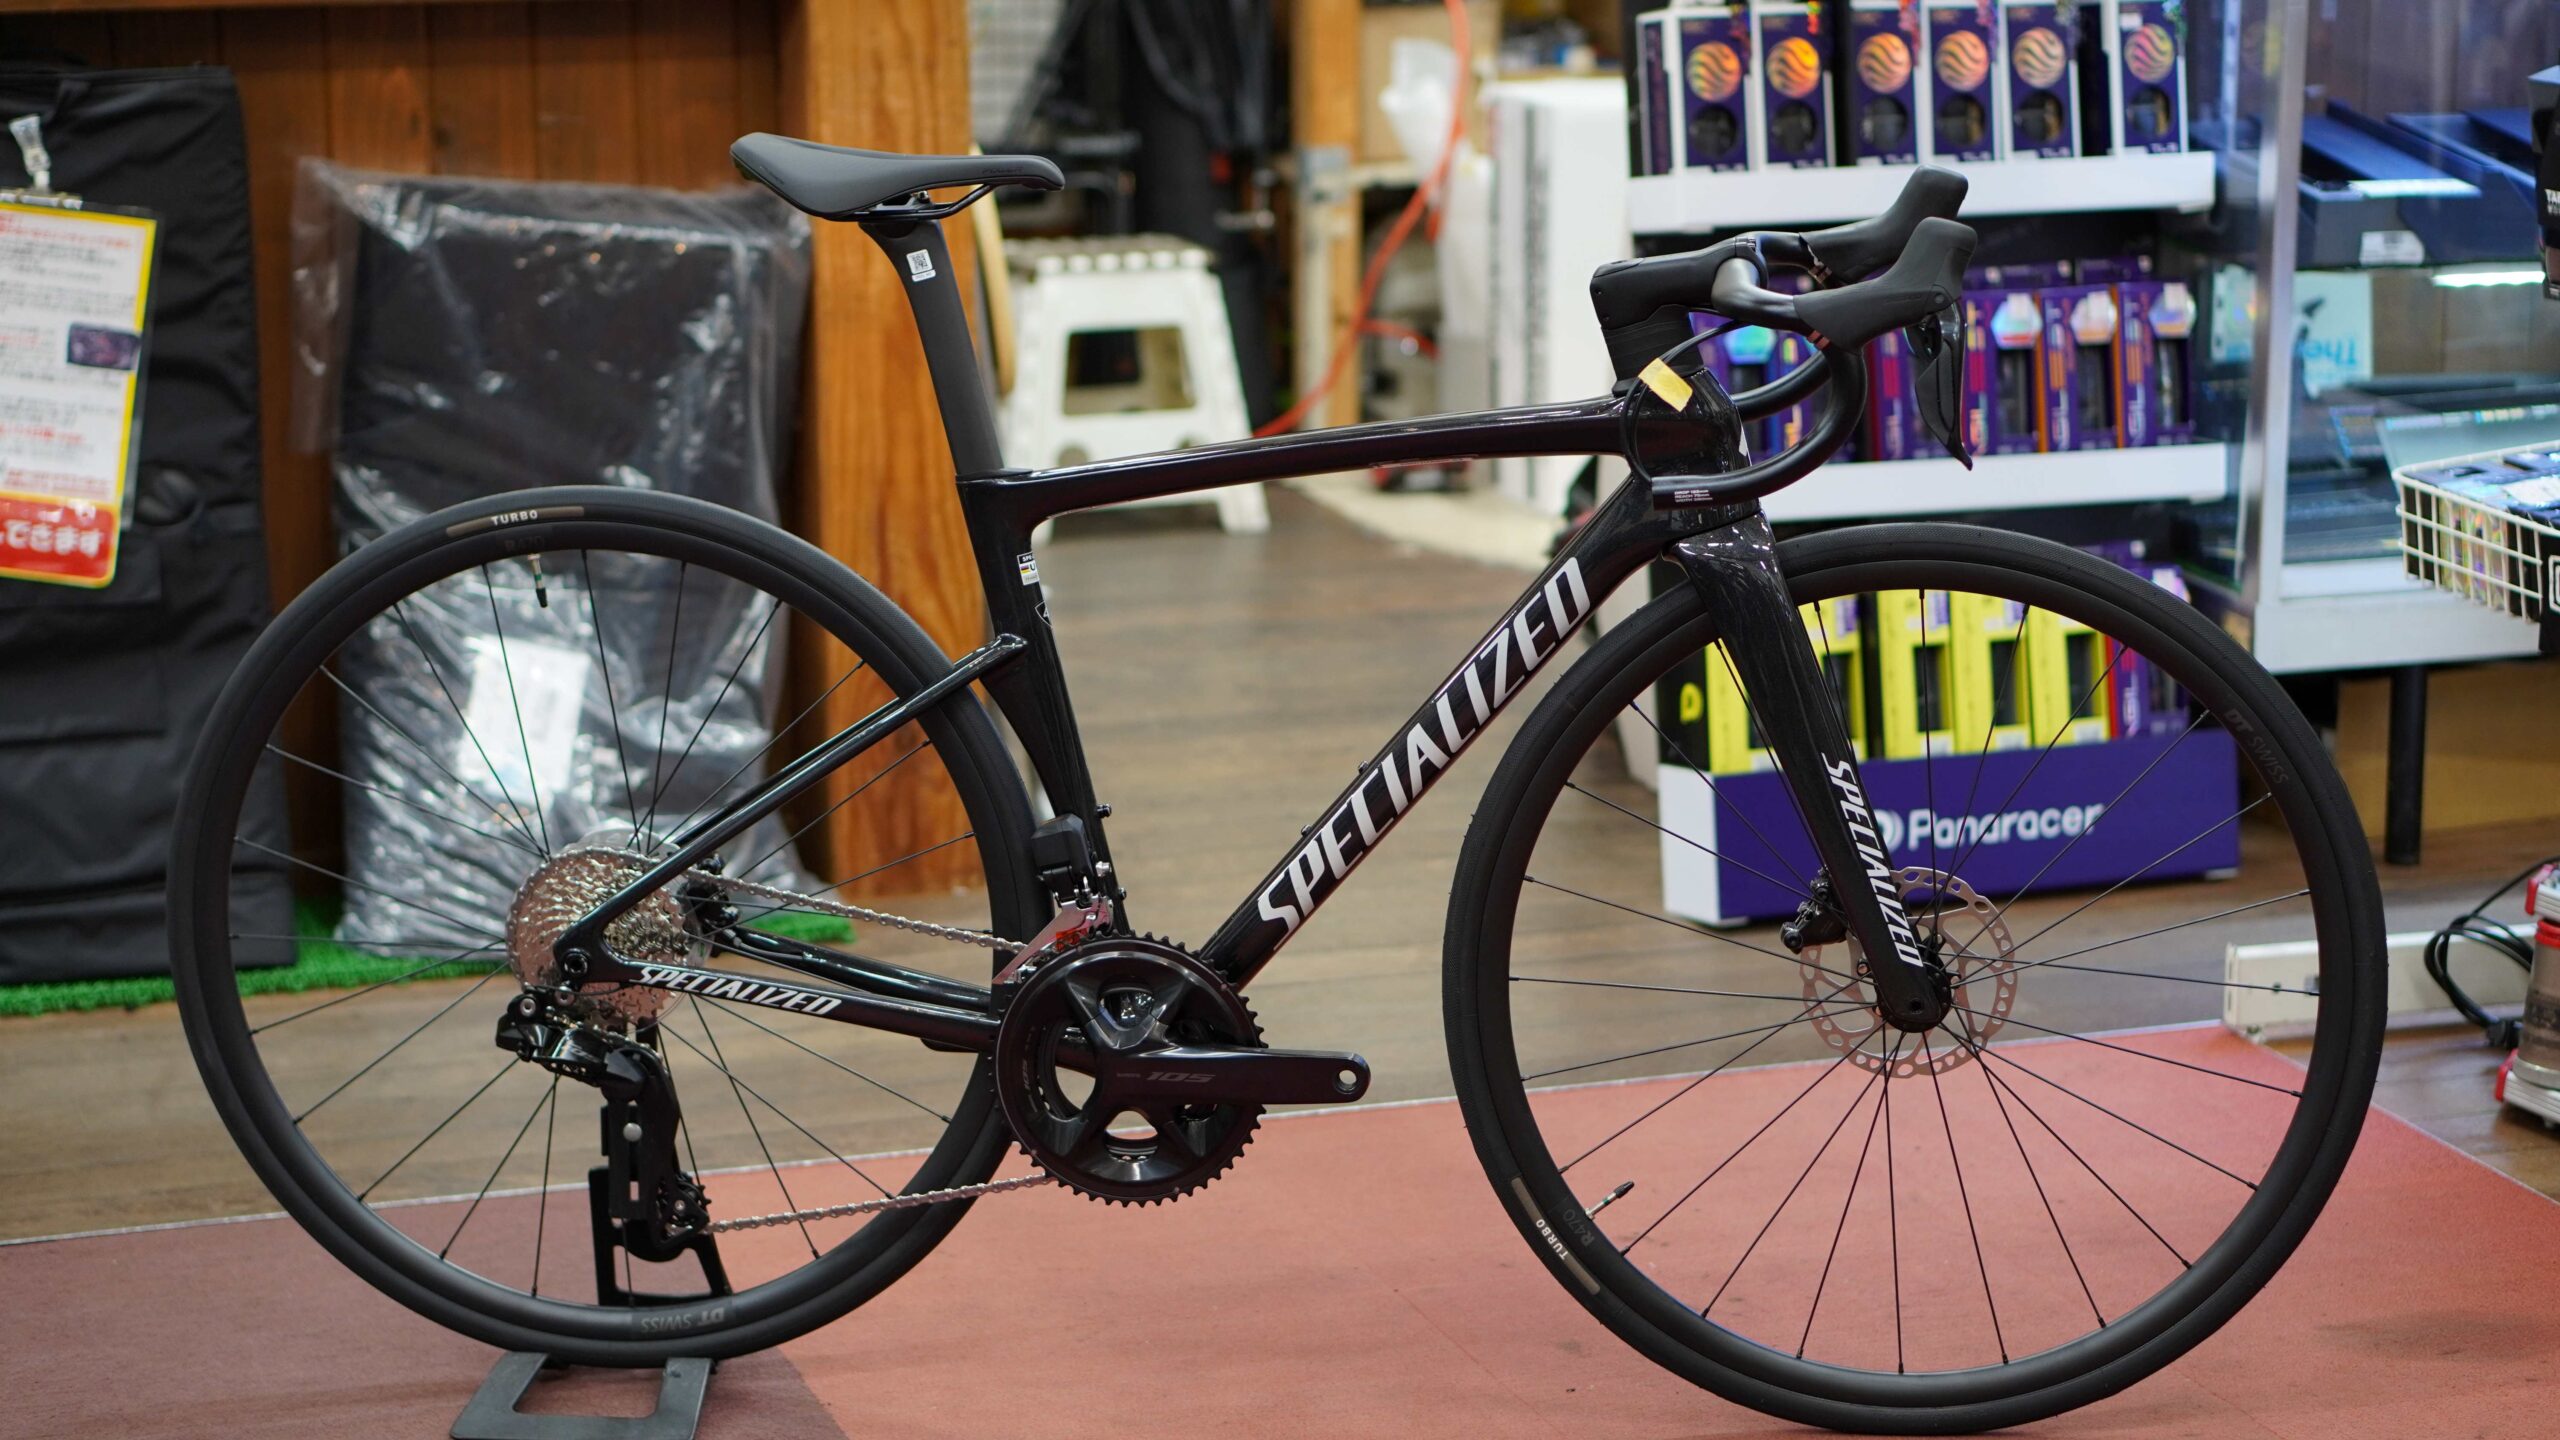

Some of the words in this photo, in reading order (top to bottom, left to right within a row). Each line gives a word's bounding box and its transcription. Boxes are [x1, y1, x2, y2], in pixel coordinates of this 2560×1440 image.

[0, 518, 105, 558] できます
[491, 509, 538, 526] TURBO
[1257, 556, 1590, 952] SPECIALIZED
[2223, 708, 2254, 732] DT
[2247, 736, 2289, 784] SWISS
[1908, 803, 2105, 850] Panaracer
[1821, 752, 1924, 967] SPECIALIZED
[629, 966, 842, 1015] SPECIALIZED
[1146, 1071, 1217, 1083] 105
[1535, 1218, 1568, 1261] TURBO
